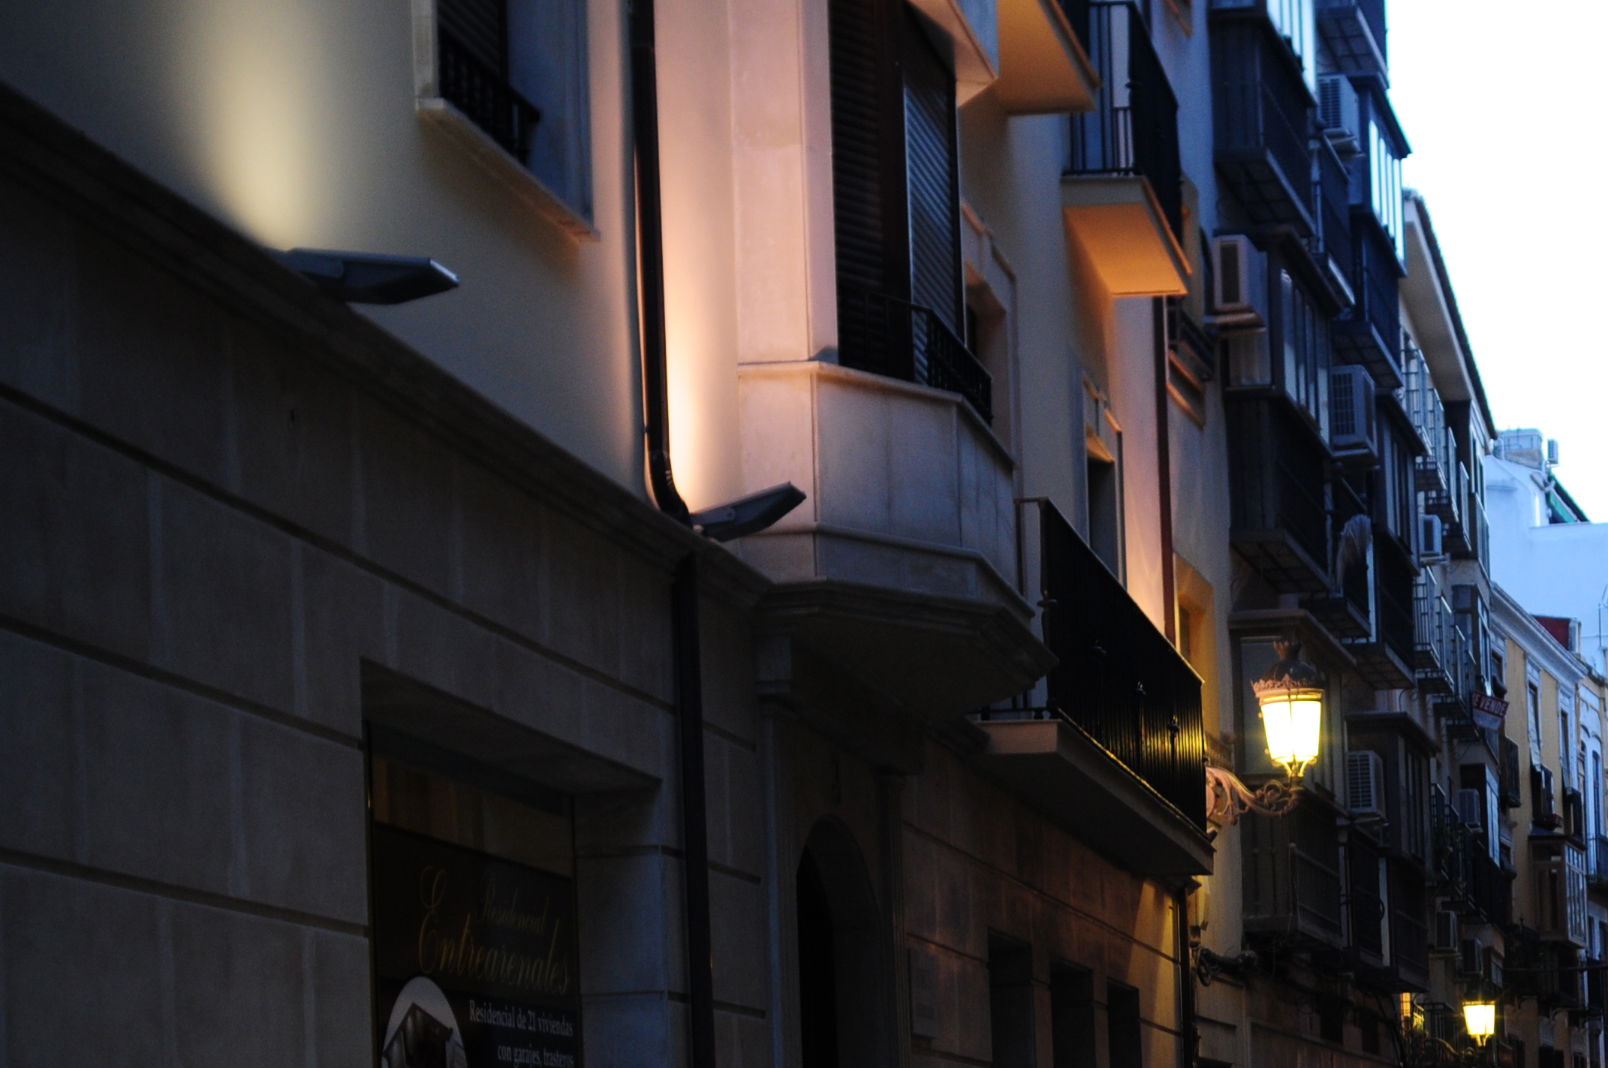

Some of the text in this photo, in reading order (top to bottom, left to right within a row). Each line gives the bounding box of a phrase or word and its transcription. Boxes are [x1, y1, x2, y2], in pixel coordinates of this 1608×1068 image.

[417, 865, 570, 994] Entrearenales
[469, 999, 516, 1030] Residencial
[516, 1008, 527, 1030] de
[537, 1011, 574, 1038] viviendas
[497, 1045, 511, 1062] con
[543, 1048, 575, 1068] trasteros
